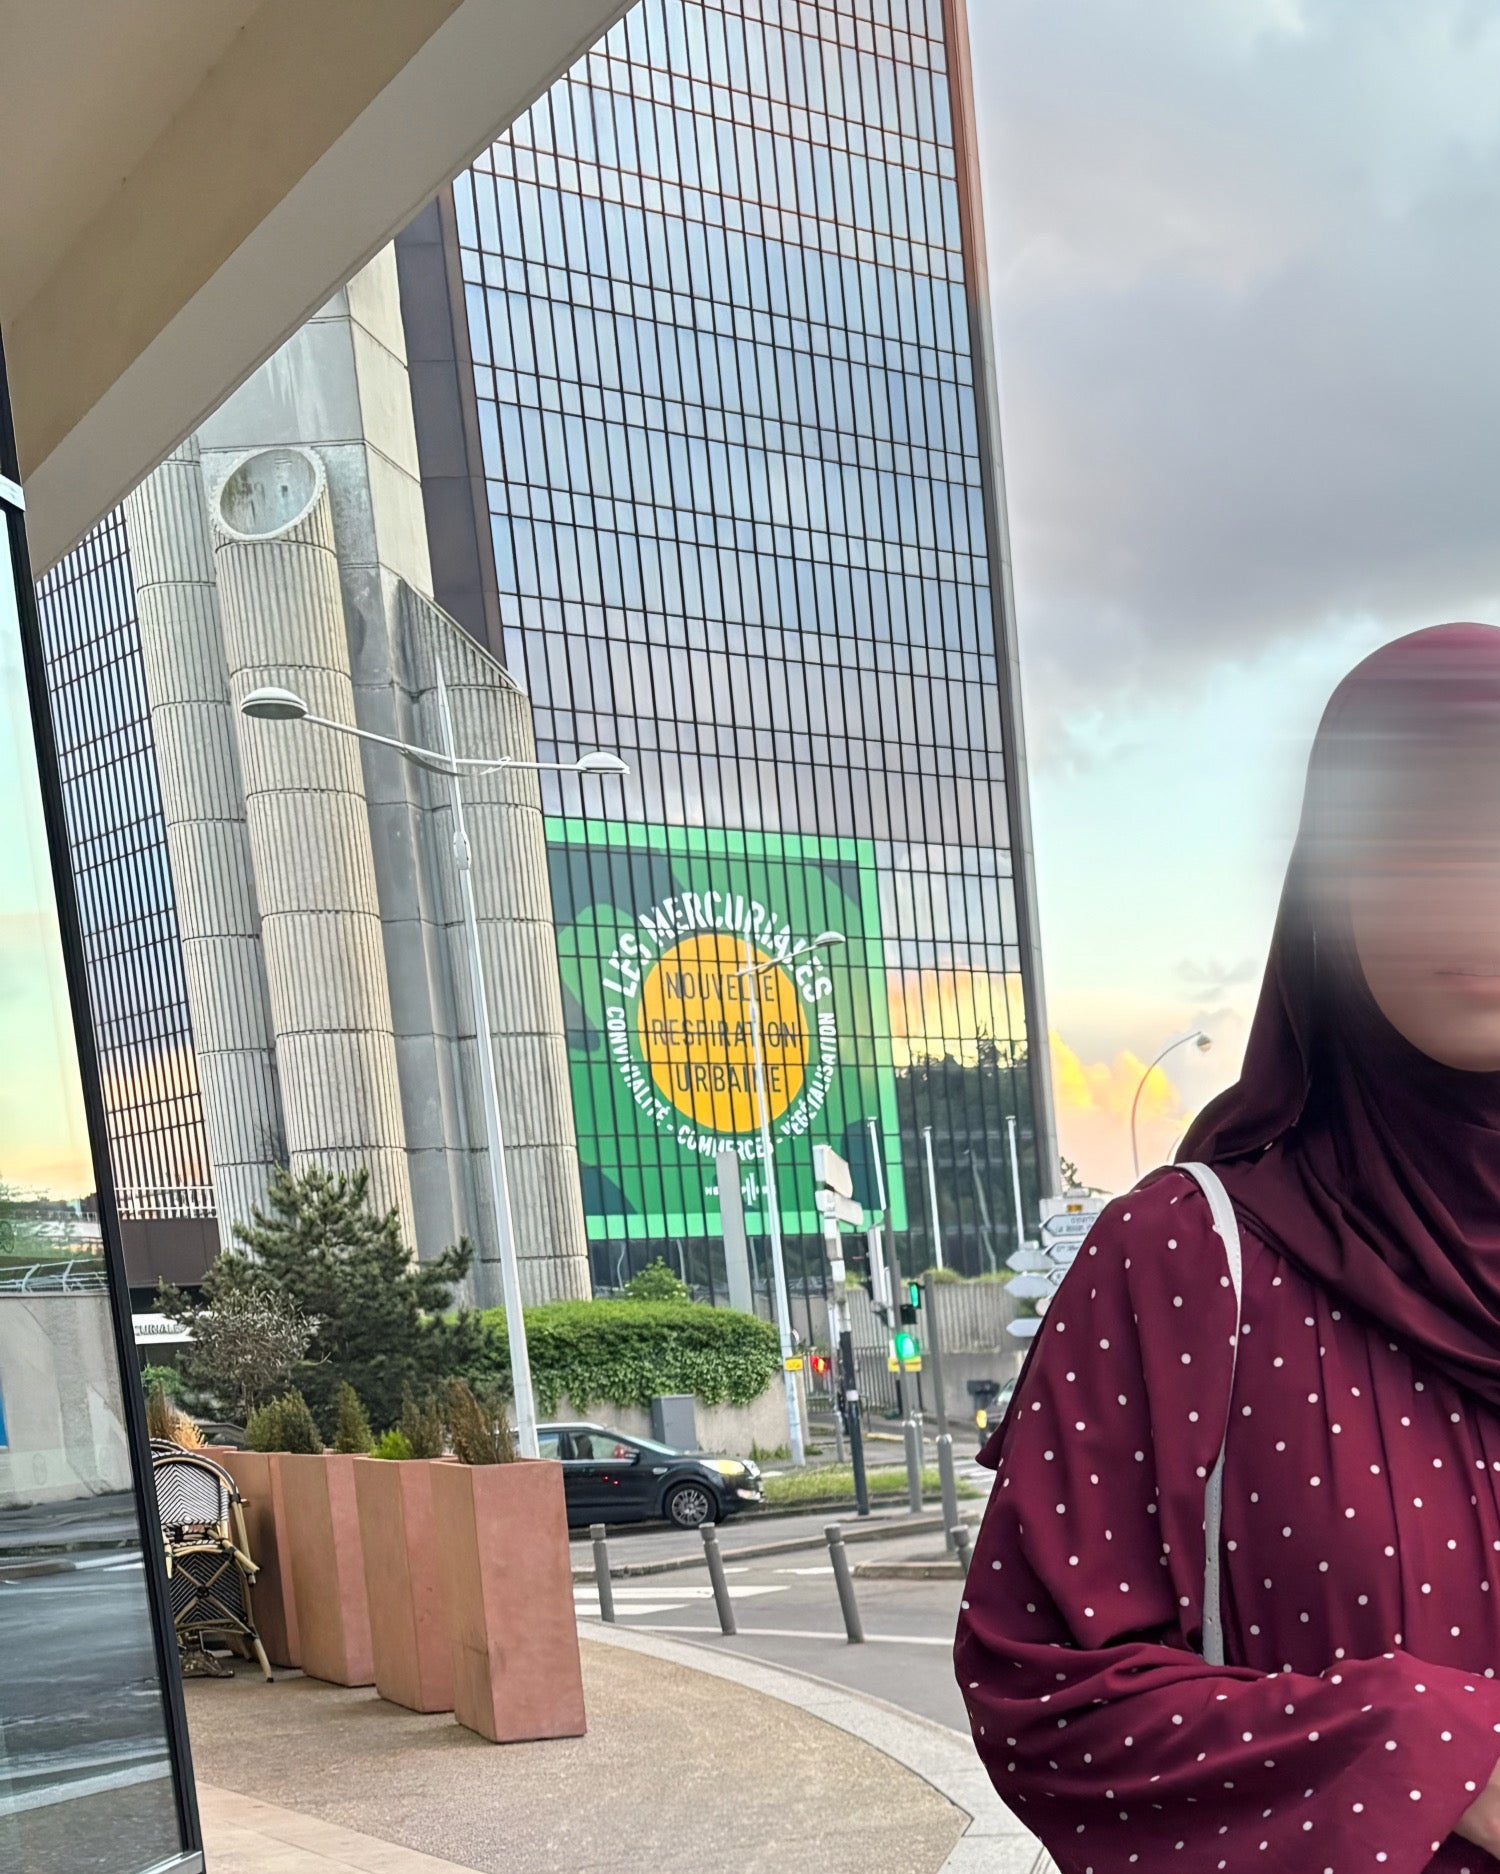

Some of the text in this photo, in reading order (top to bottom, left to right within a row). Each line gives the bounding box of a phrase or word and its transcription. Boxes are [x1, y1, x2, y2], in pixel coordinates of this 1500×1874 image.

[602, 890, 832, 1003] LES MERCURIALES
[665, 971, 775, 1002] NOUVELLE
[651, 1018, 798, 1048] RESPIRATON
